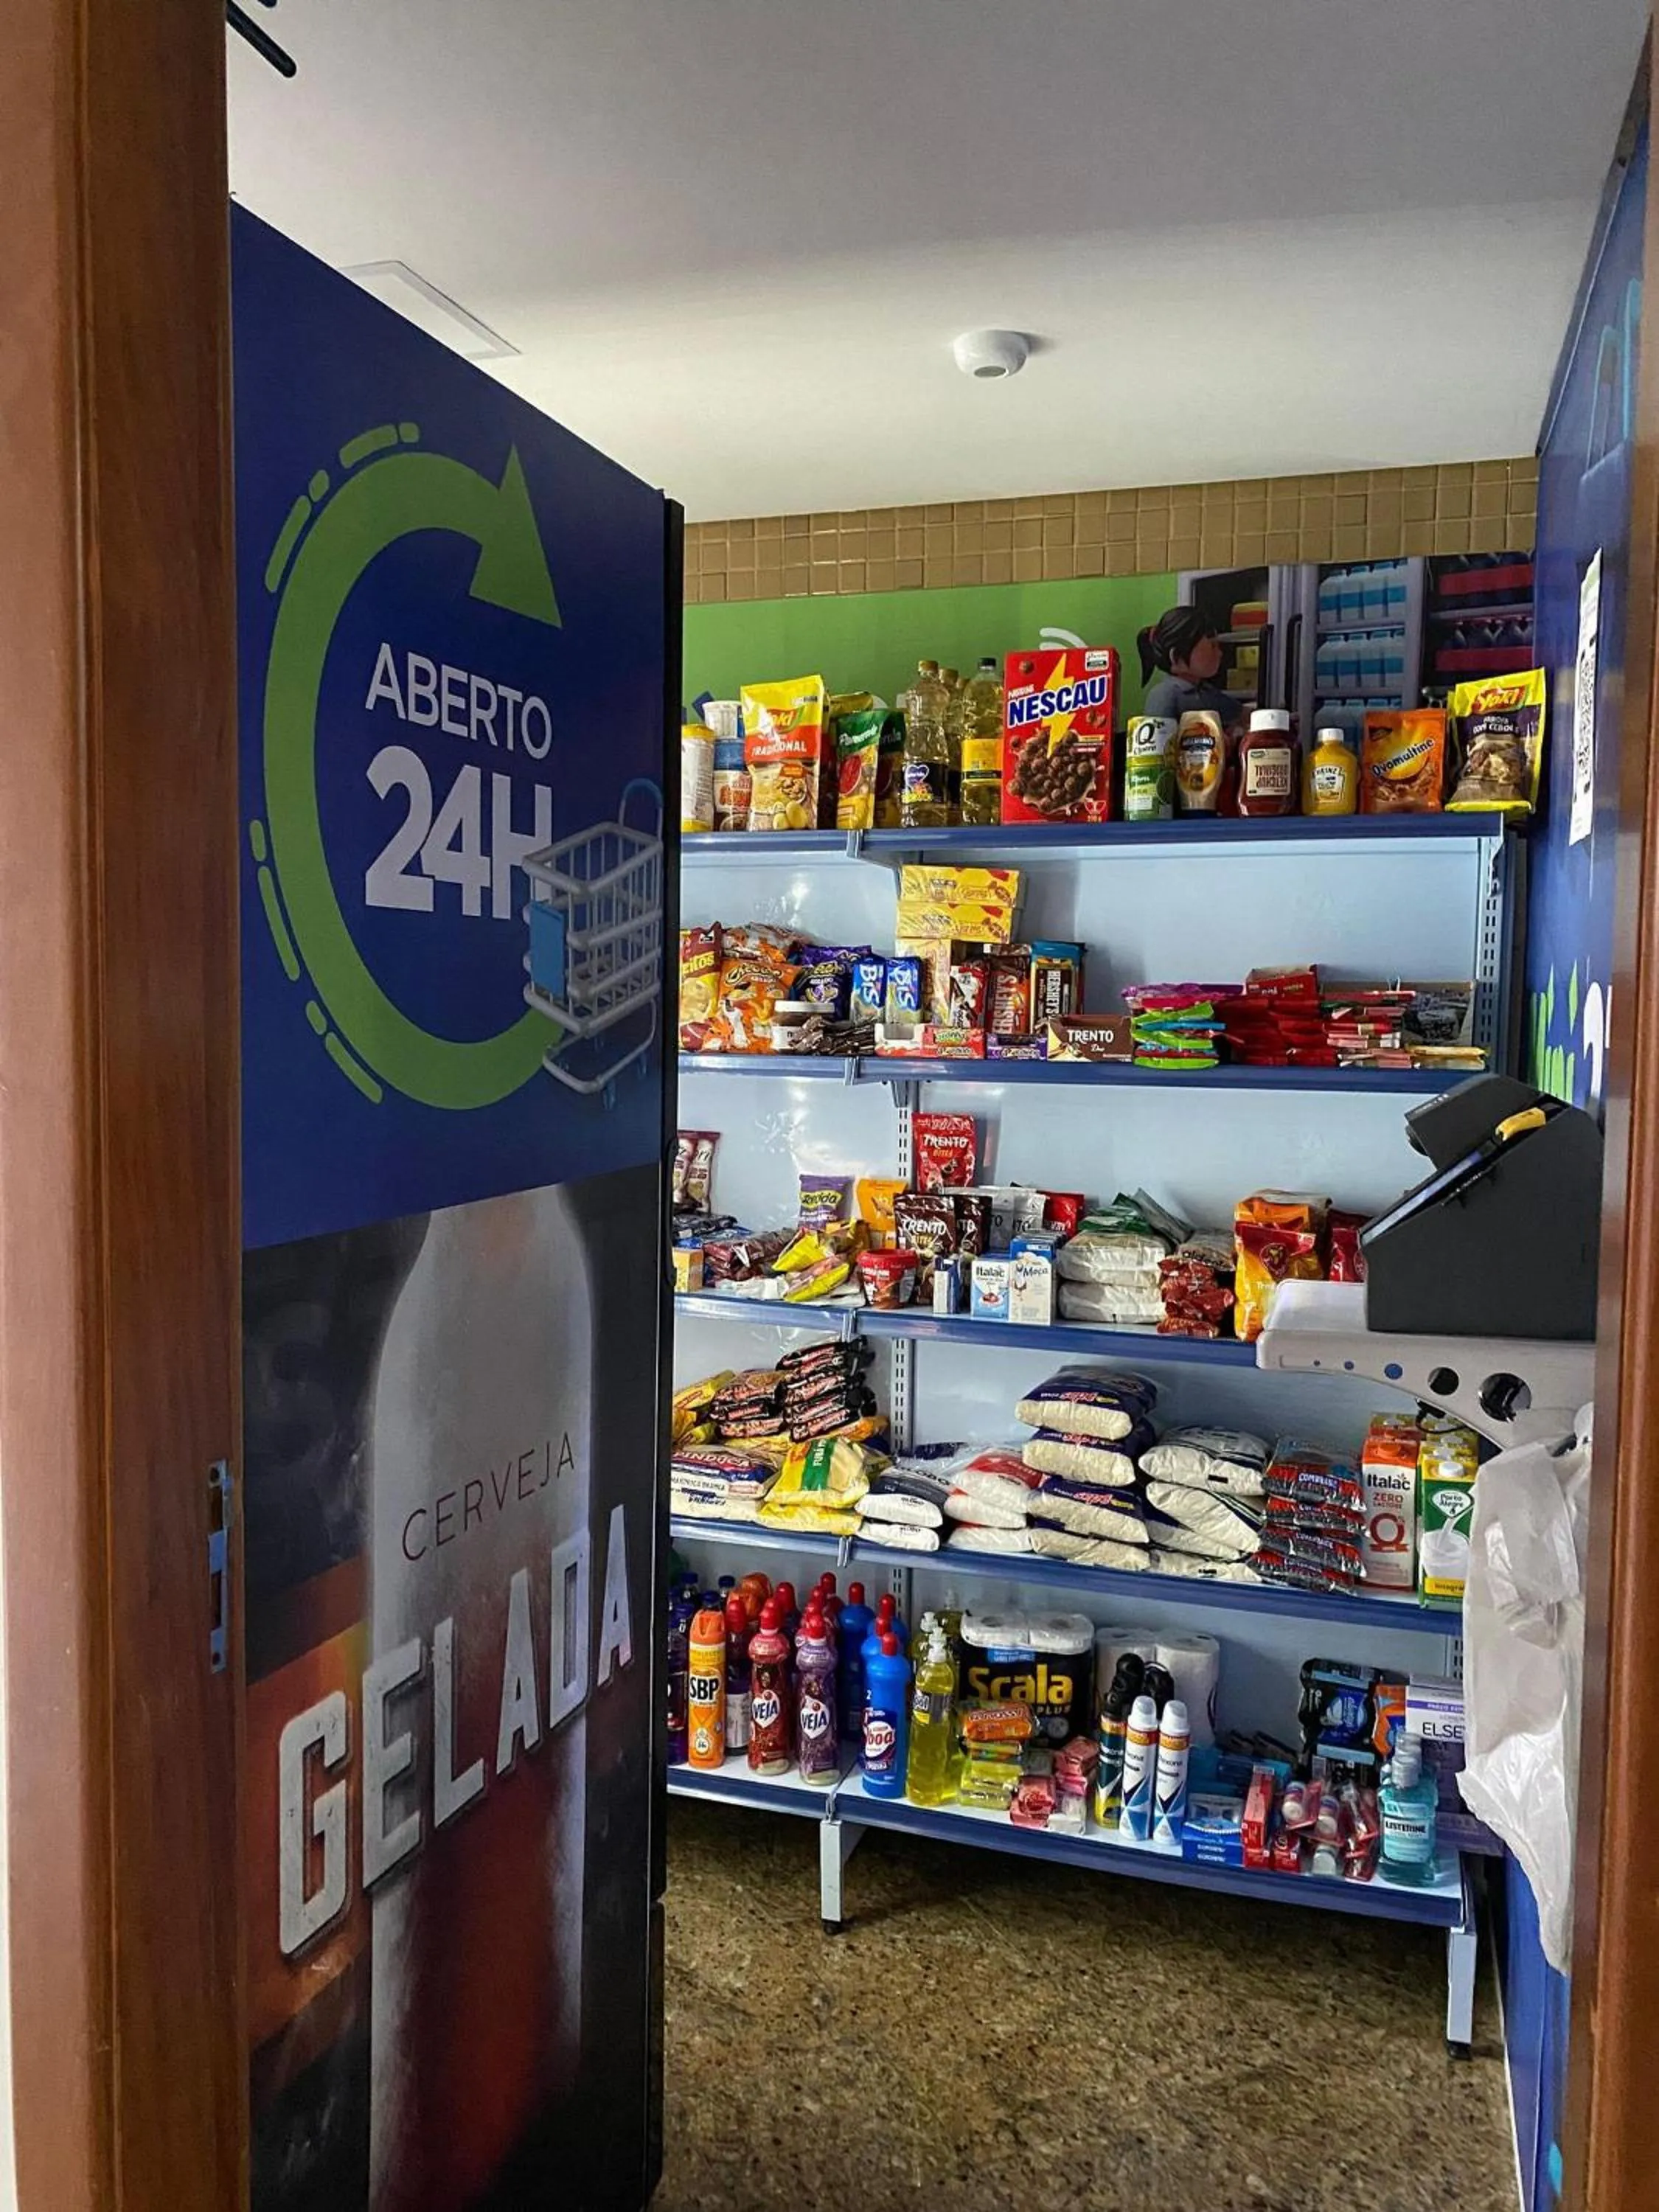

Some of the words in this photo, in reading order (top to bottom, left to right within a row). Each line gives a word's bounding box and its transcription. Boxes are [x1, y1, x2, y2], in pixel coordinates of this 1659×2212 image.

[364, 642, 553, 759] ABERTO
[1007, 675, 1107, 728] NESCAU
[364, 745, 553, 919] 24H
[993, 974, 1018, 1034] ERSHEY'S
[1067, 1029, 1114, 1042] TRENTO
[922, 1133, 969, 1148] TRENTO
[901, 1217, 947, 1237] TRENTO
[1367, 1473, 1411, 1491] Italac
[402, 1431, 576, 1562] CERVEJA
[1373, 1492, 1404, 1504] ZERO
[1440, 1492, 1463, 1502] Porto
[689, 1676, 720, 1702] SBP
[967, 1663, 1073, 1705] Scala
[752, 1700, 779, 1719] VEJA
[279, 1503, 633, 1955] GELADA
[801, 1711, 828, 1729] VEJA
[1422, 1722, 1465, 1739] ELSE
